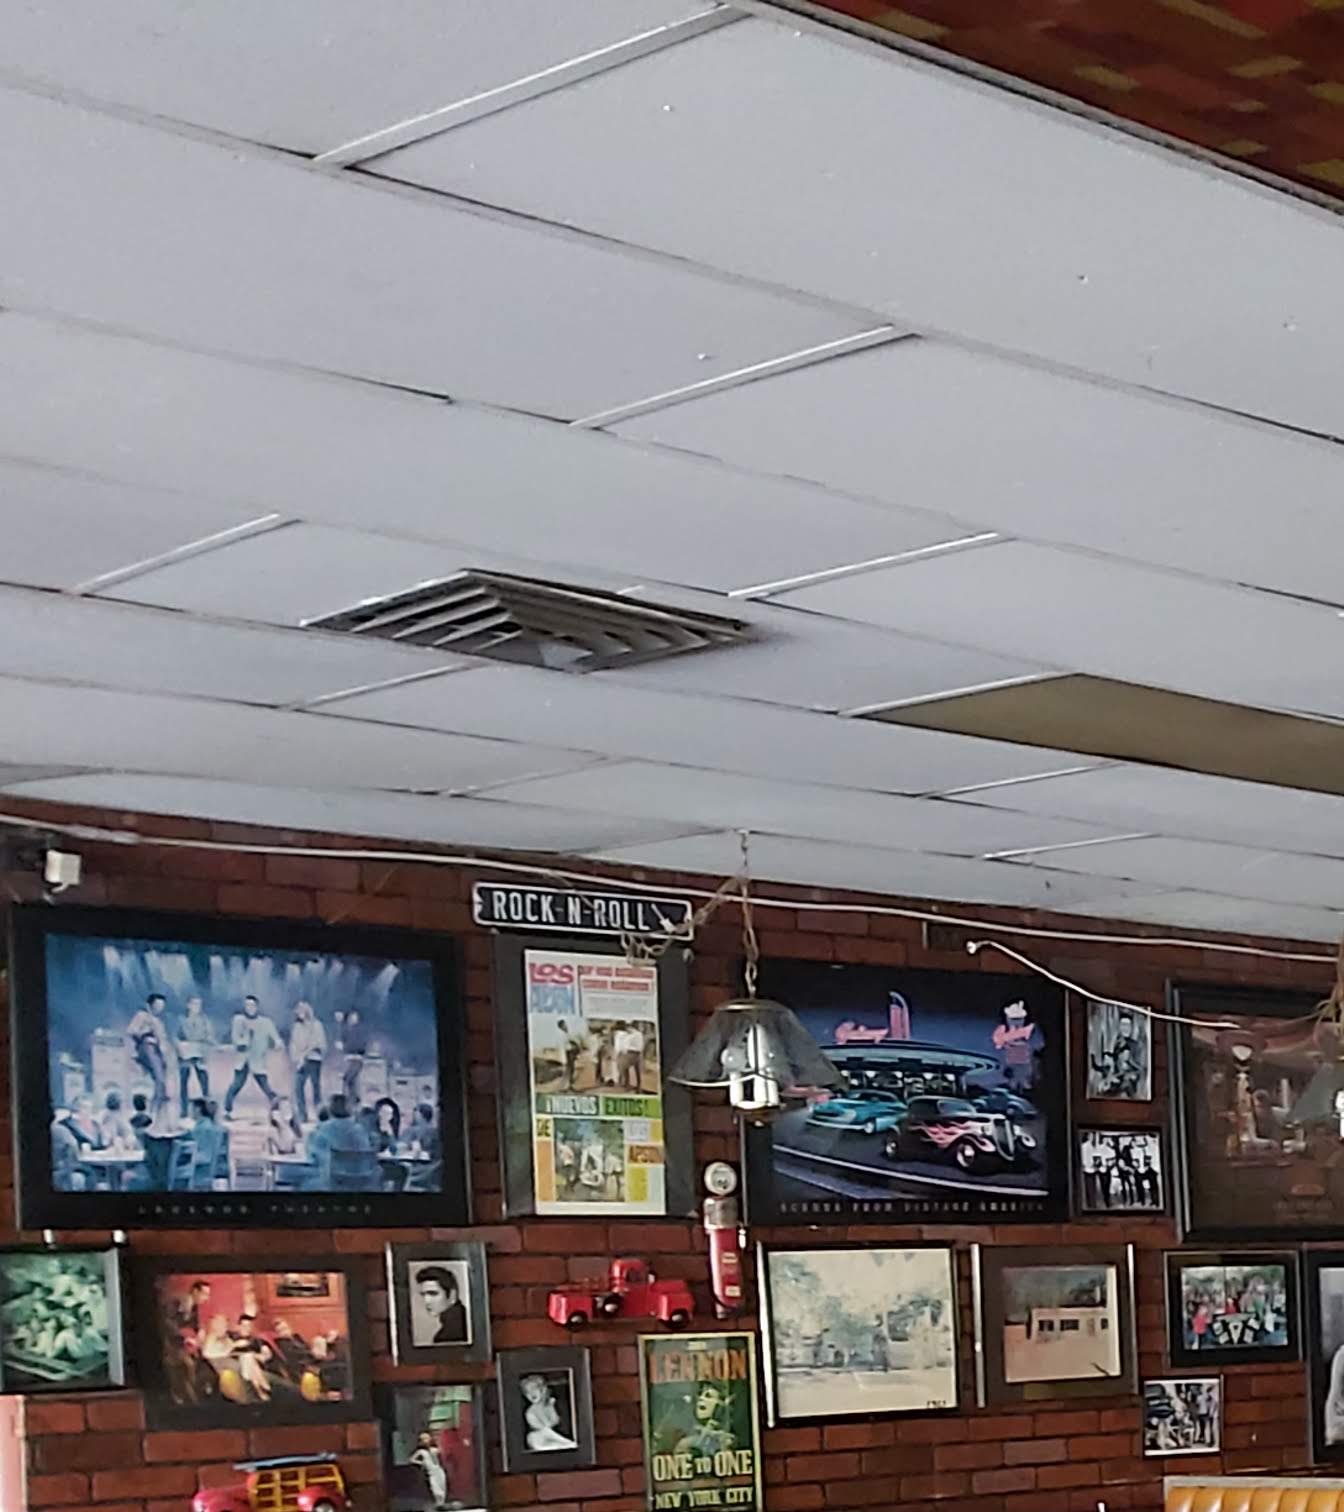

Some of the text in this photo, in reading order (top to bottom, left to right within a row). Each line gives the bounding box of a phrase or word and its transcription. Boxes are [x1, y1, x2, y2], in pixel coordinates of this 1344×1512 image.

[652, 1455, 694, 1481] ONE
[714, 1451, 753, 1477] ONE
[725, 1486, 754, 1503] CITY
